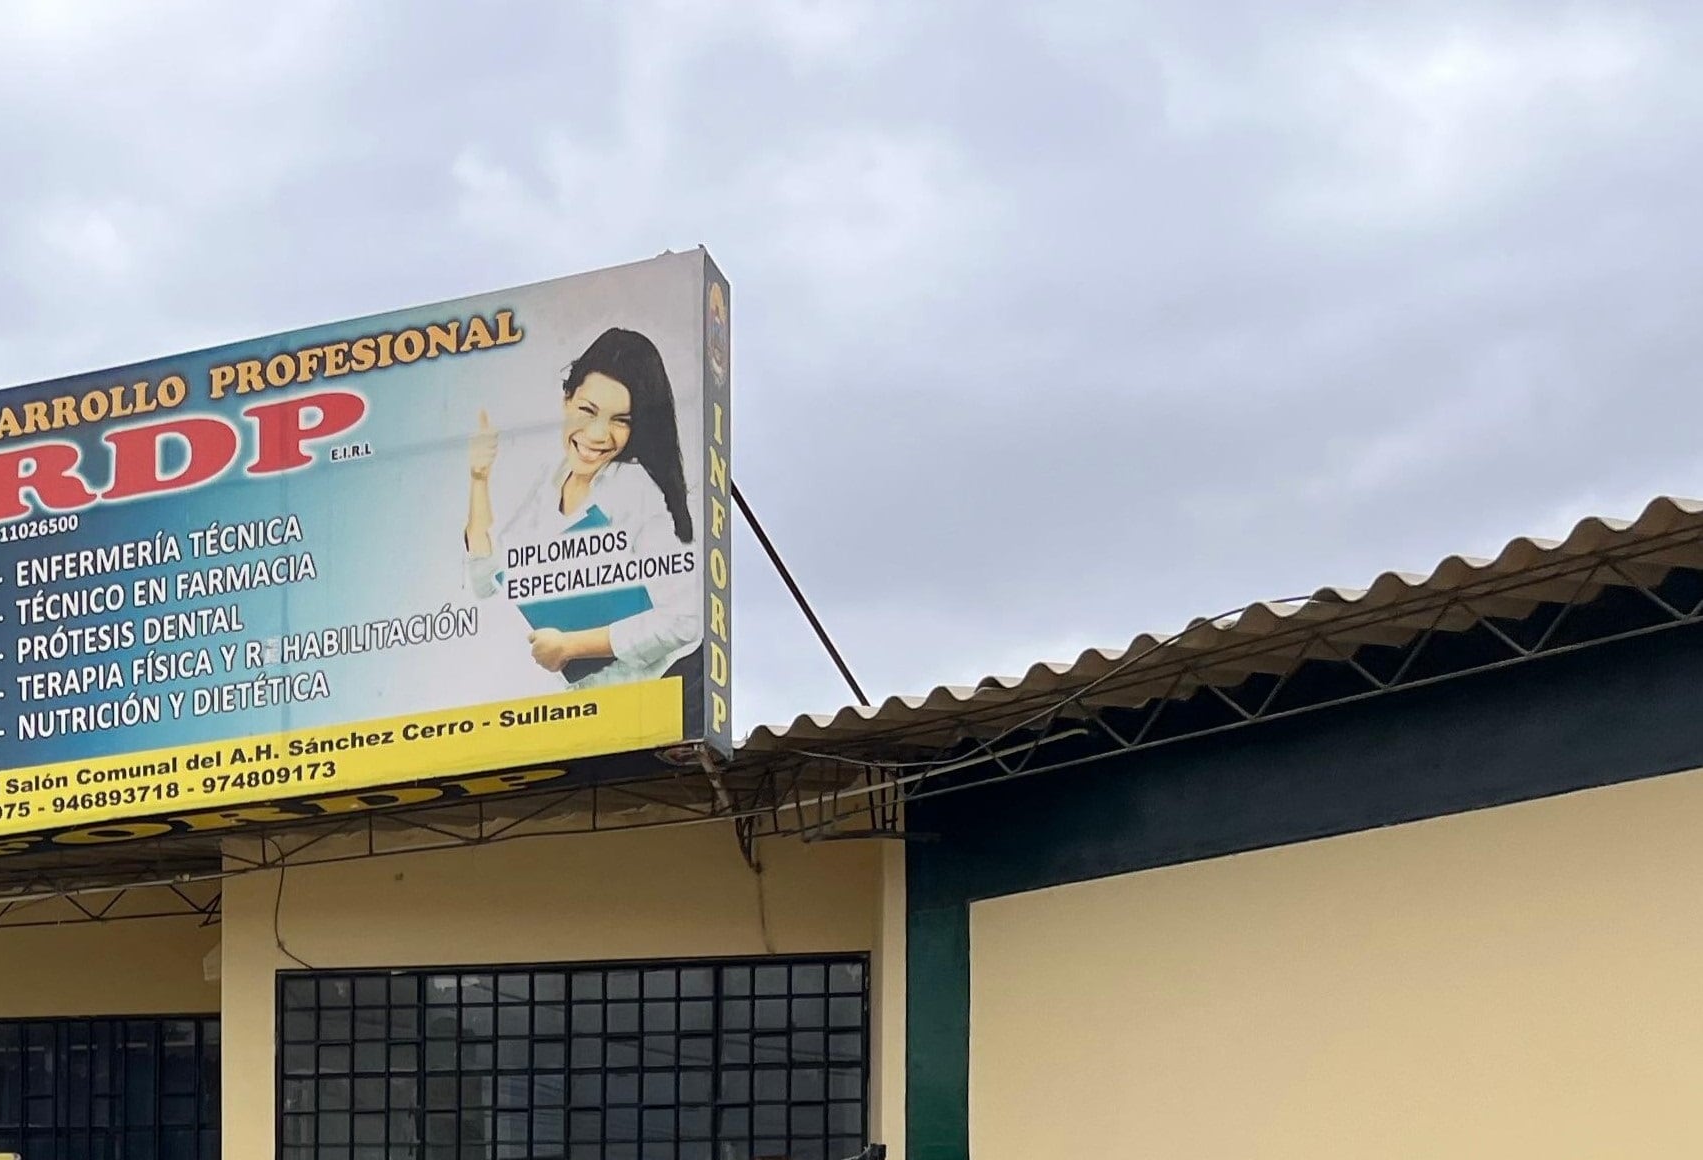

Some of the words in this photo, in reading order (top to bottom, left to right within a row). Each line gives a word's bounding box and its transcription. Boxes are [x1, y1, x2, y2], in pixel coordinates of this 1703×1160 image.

[210, 311, 524, 399] PROFESIONAL
[0, 514, 79, 543] 11026500
[16, 532, 181, 588] ENFERMERÍA
[188, 514, 303, 558] TÉCNICA
[507, 531, 628, 569] DIPLOMADOS
[15, 580, 125, 627] TÉCNICO
[132, 575, 168, 605] EN
[176, 552, 317, 600] FARMACIA
[507, 552, 695, 600] ESPECIALIZACIONES
[706, 402, 728, 734] INFORDP
[17, 618, 135, 664] PRÓTESIS
[143, 604, 244, 645] DENTAL
[17, 663, 125, 703] TERAPIA
[132, 642, 213, 683] FÍSICA
[219, 645, 238, 673] Y
[245, 603, 478, 670] RHABILITACIÓN
[17, 692, 161, 741] NUTRICIÓN
[167, 692, 186, 720] Y
[193, 671, 330, 717] DIETÉTICA
[6, 773, 68, 795] Salón
[77, 757, 178, 786] Comunal
[186, 751, 222, 772] del
[230, 744, 280, 766] A.H.
[289, 728, 394, 758] Sánchez
[402, 715, 475, 742] Cerro
[499, 700, 598, 729] Sullana
[52, 782, 180, 813] 946893718
[202, 761, 337, 794] 974809173
